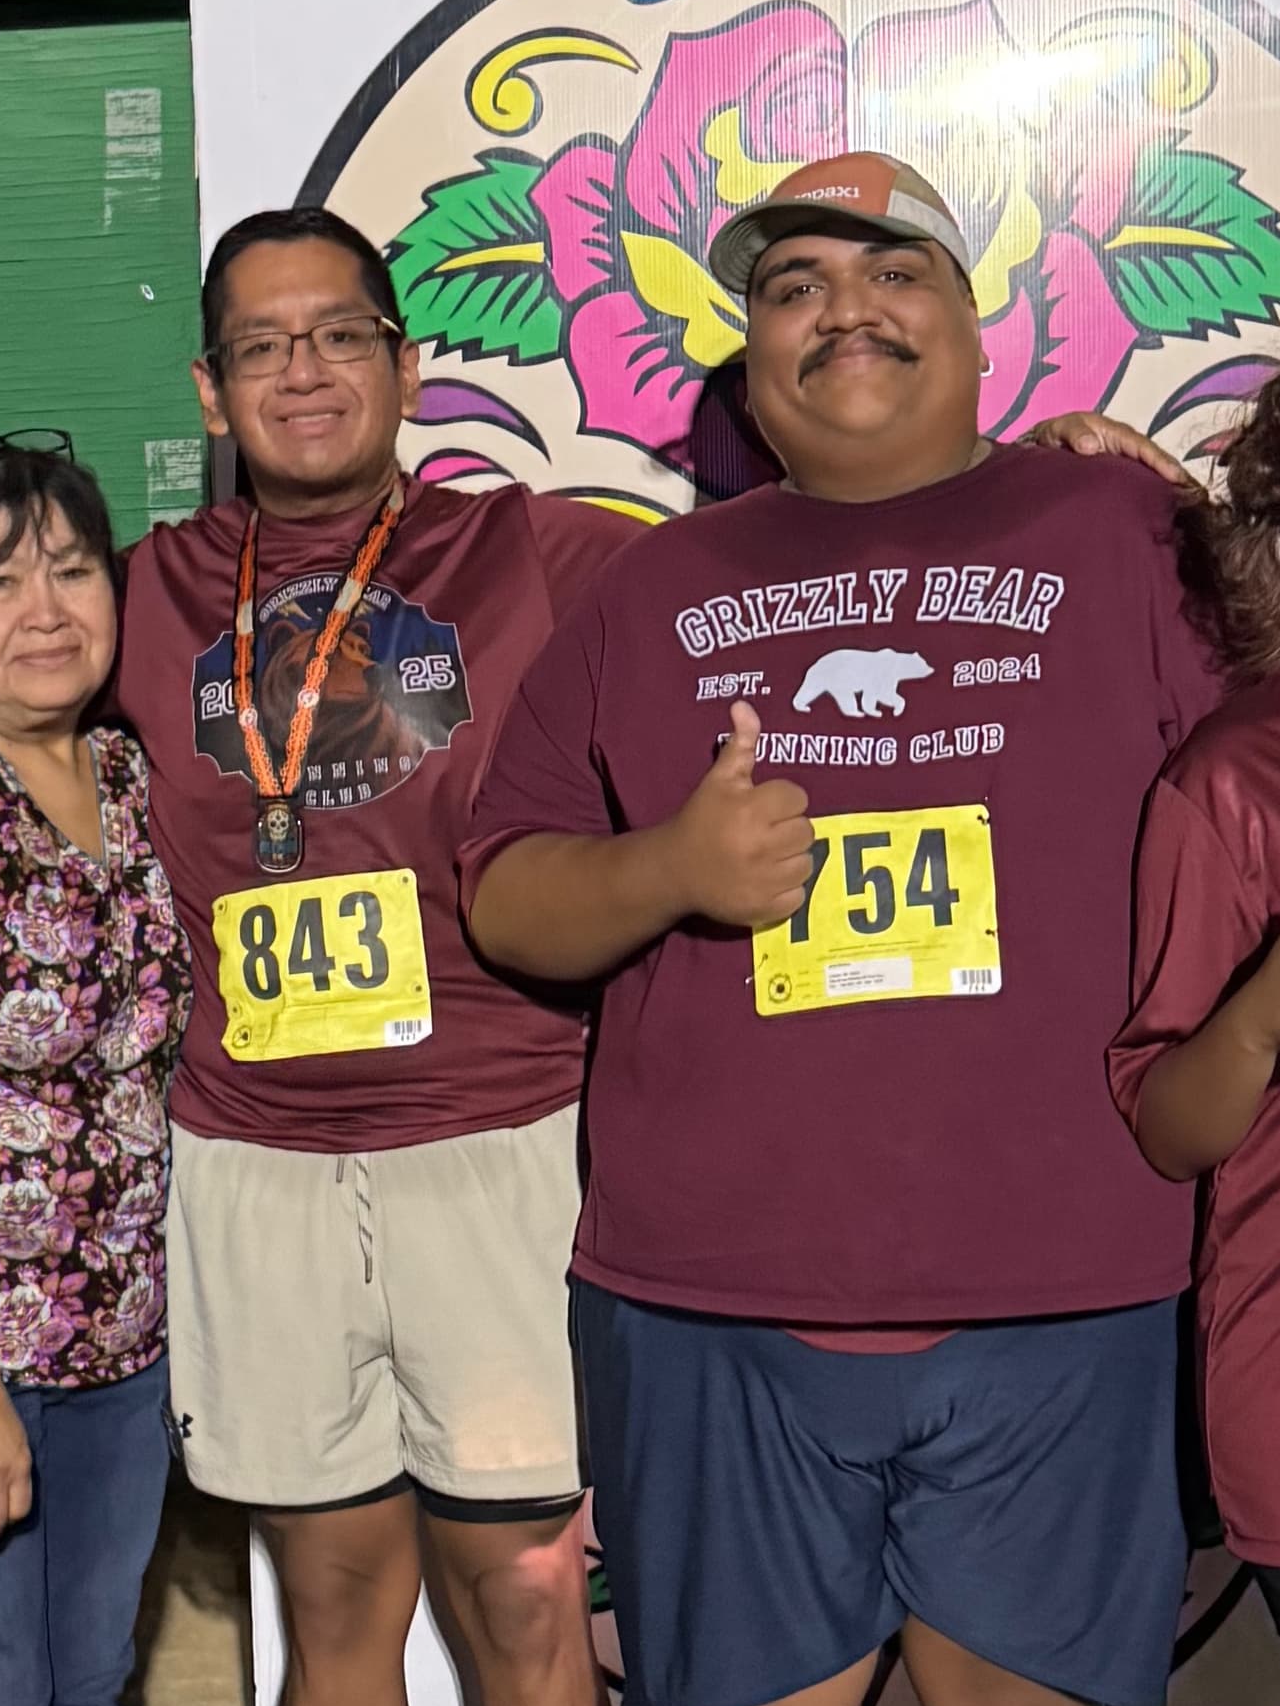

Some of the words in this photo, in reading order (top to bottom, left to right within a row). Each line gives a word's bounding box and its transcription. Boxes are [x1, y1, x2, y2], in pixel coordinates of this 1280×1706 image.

[675, 569, 908, 659] GRIZZLY
[916, 565, 1064, 635] BEAR
[399, 654, 457, 693] 25
[696, 672, 771, 701] EST.
[952, 654, 1042, 687] 2024
[717, 733, 897, 765] NNING
[909, 723, 1005, 763] CLUB
[790, 828, 960, 944] 754
[239, 890, 389, 1000] 843
